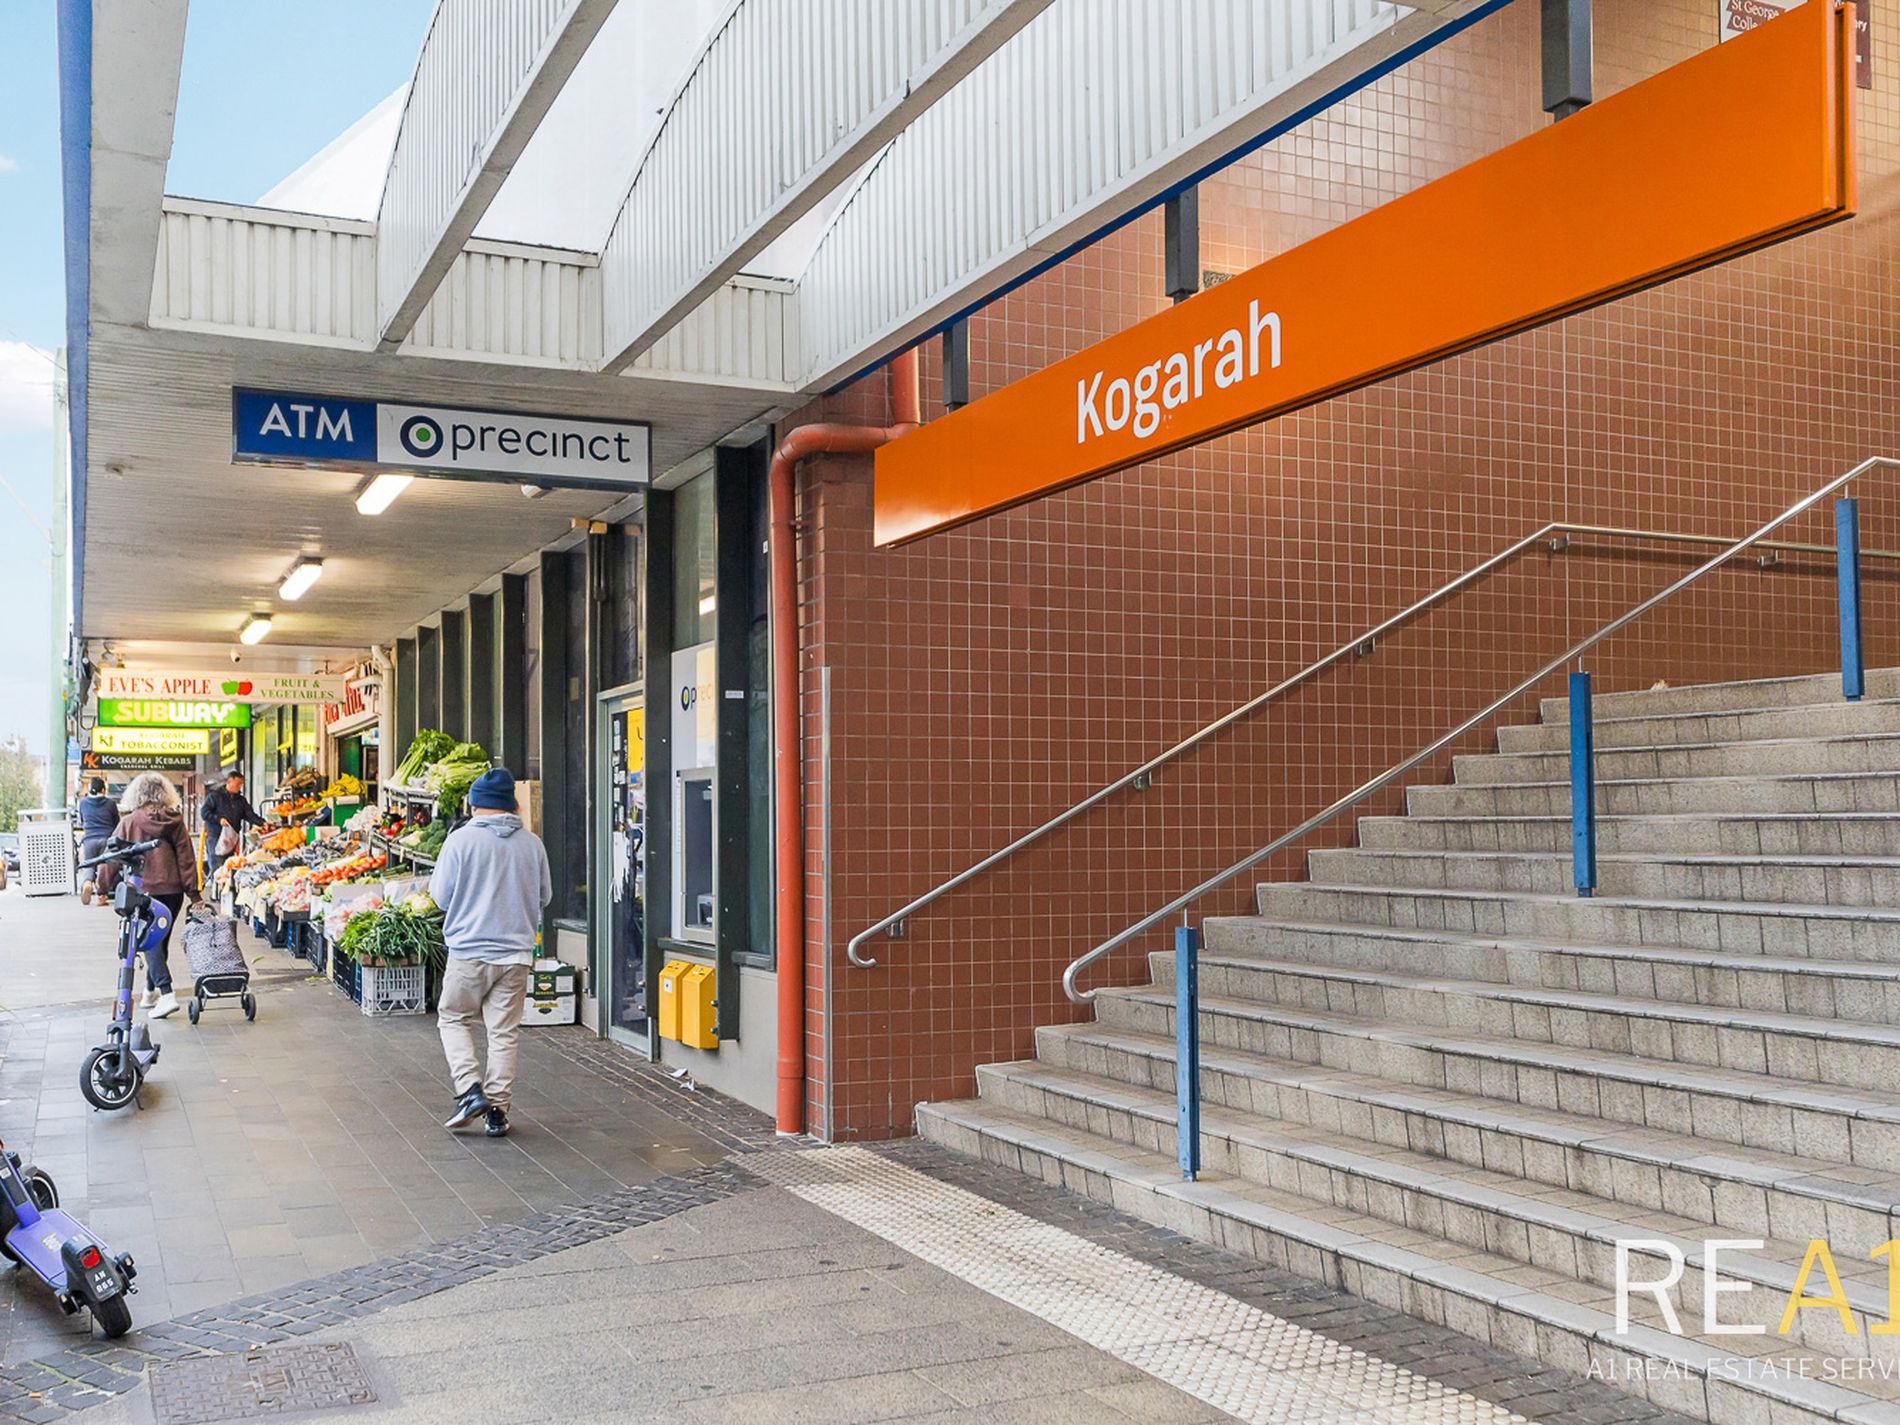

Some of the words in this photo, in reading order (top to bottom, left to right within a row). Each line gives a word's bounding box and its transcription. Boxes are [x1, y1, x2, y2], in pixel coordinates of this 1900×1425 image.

[1077, 299, 1281, 444] Kogarah
[259, 403, 354, 442] ATM
[452, 423, 631, 463] precinct
[108, 676, 155, 694] EVE'S
[161, 678, 211, 695] APPLE
[274, 678, 308, 688] FRUIT
[312, 680, 320, 688] &
[260, 689, 334, 699] VEGETABLES
[112, 701, 236, 724] SUBWAY
[121, 741, 203, 751] TOBACCONIST
[101, 755, 151, 764] KOGARAH
